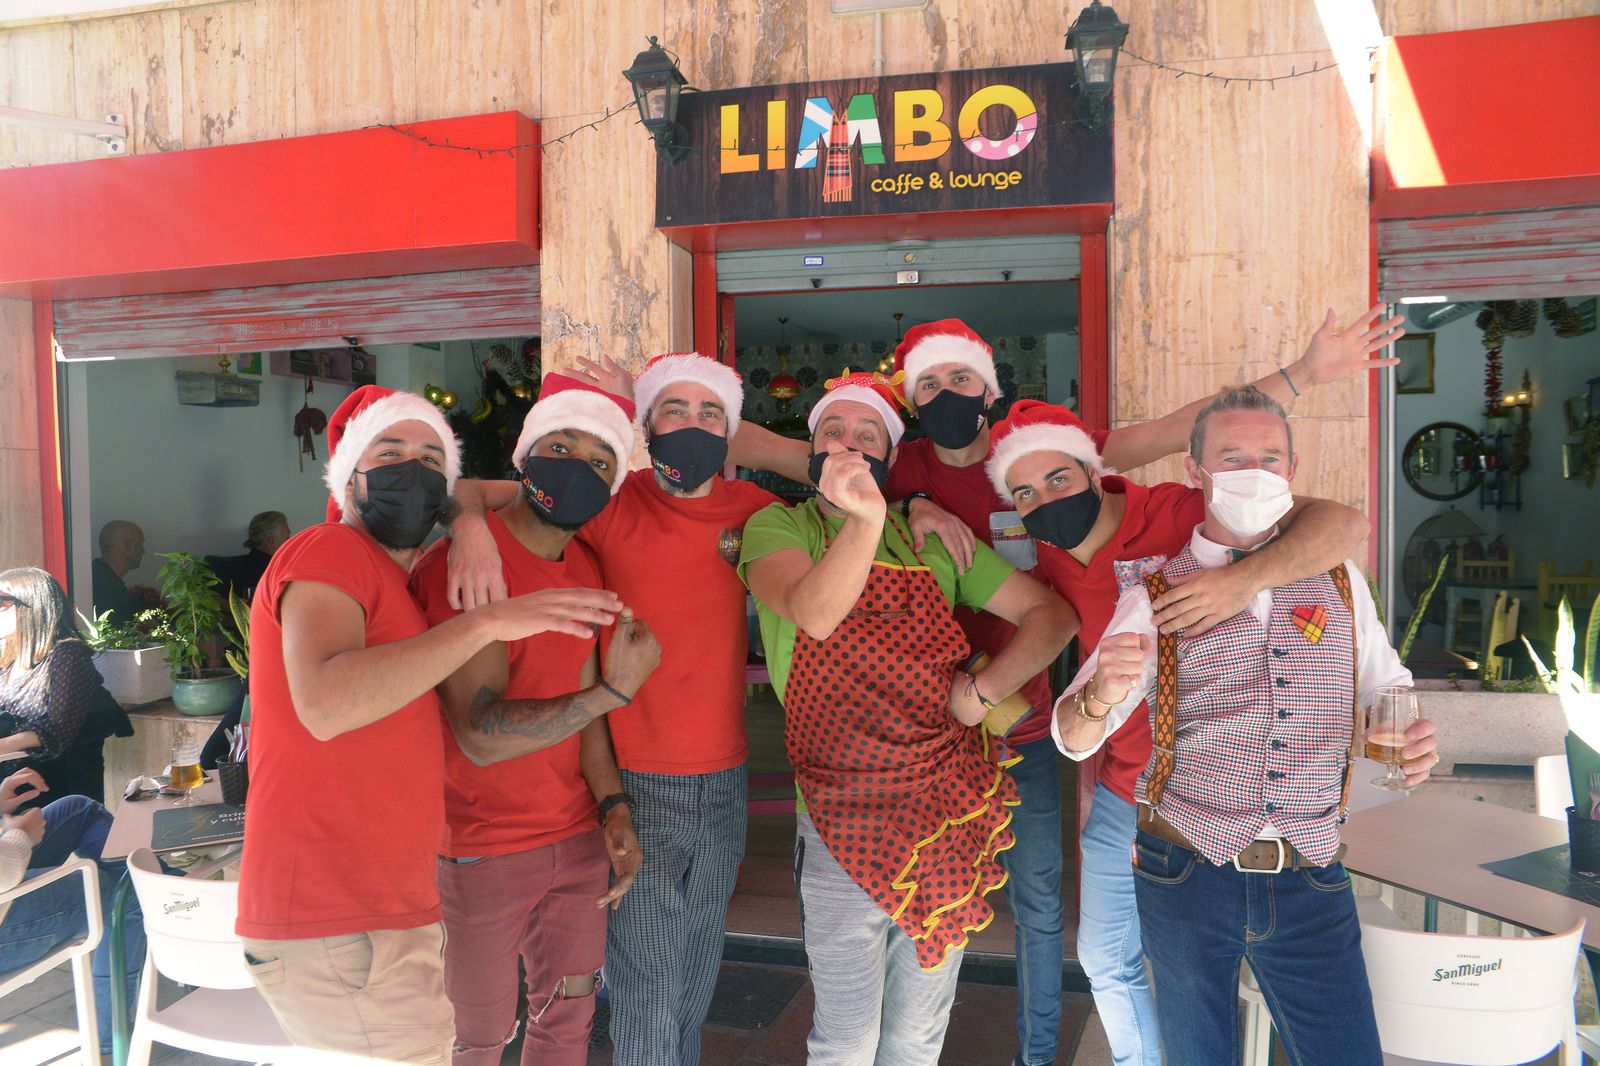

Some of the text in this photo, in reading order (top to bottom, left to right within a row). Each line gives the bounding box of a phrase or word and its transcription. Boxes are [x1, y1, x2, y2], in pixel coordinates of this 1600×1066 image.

[720, 84, 1038, 174] LIMBO
[871, 169, 1023, 194] caffe & lounge
